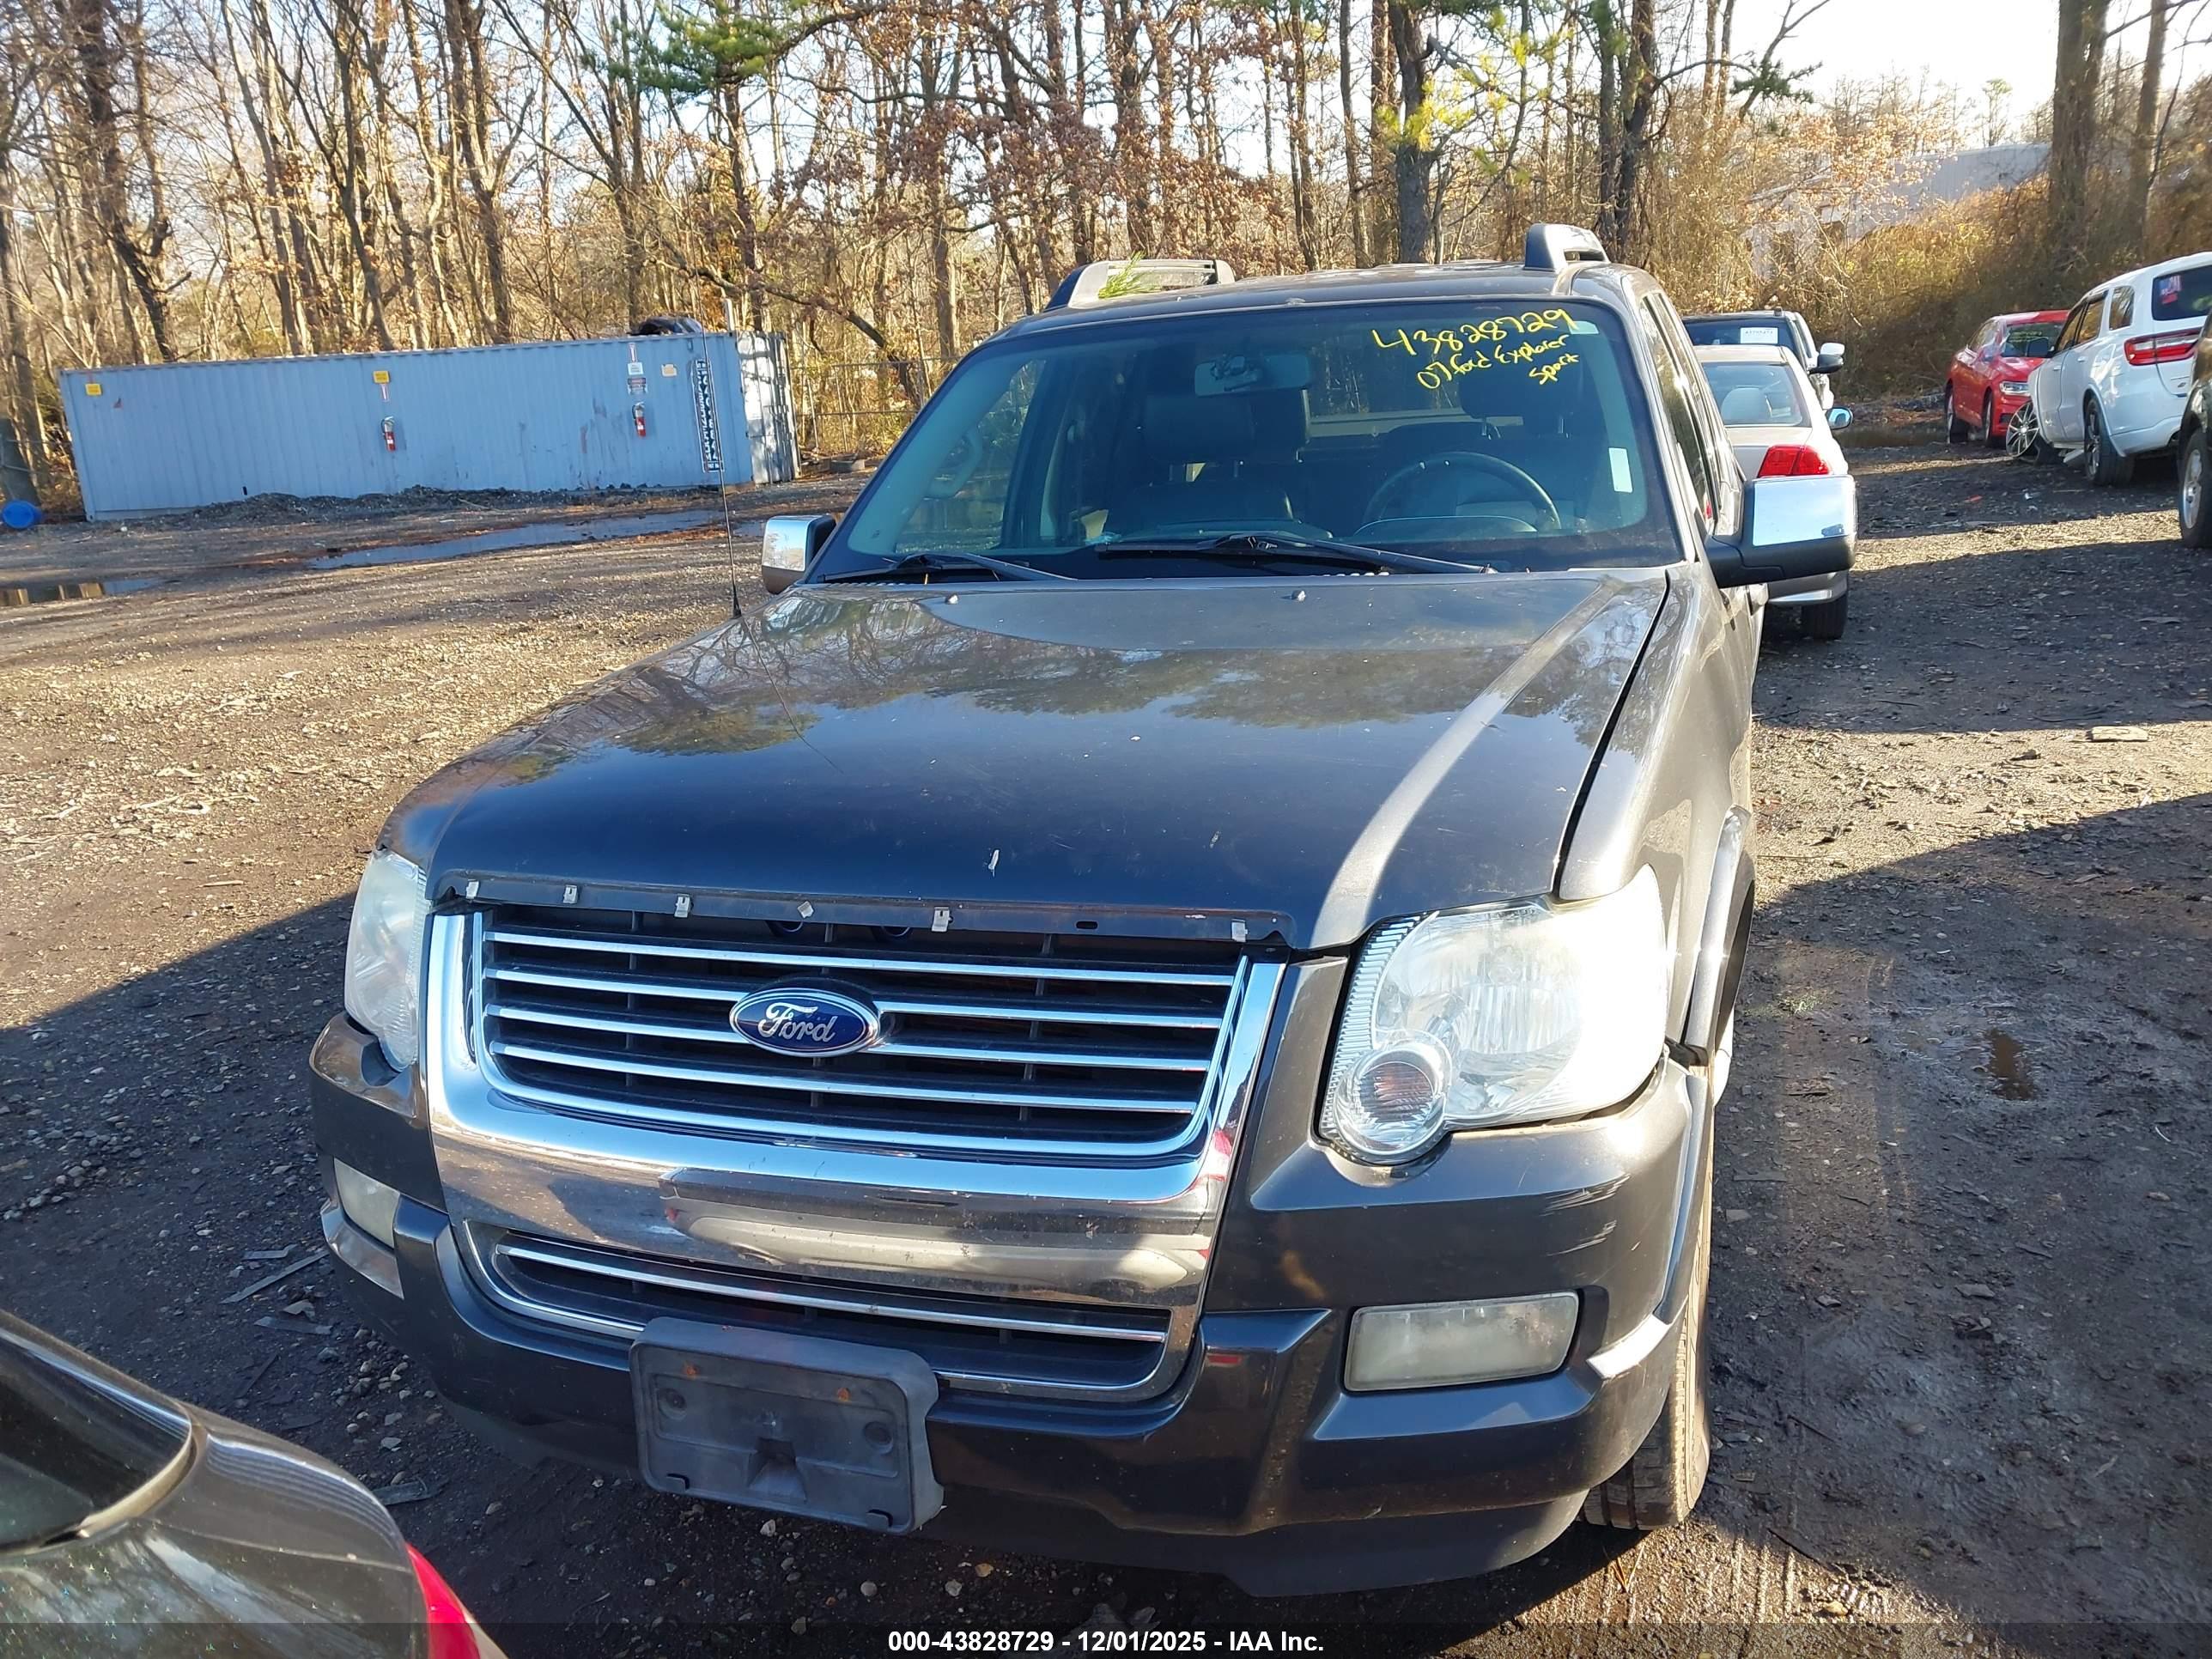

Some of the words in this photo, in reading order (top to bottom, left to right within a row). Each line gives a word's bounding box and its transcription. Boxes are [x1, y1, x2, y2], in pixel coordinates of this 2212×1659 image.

[1371, 308, 1580, 356] 43828729
[1417, 361, 1453, 389] 07
[757, 1002, 839, 1043] Ford
